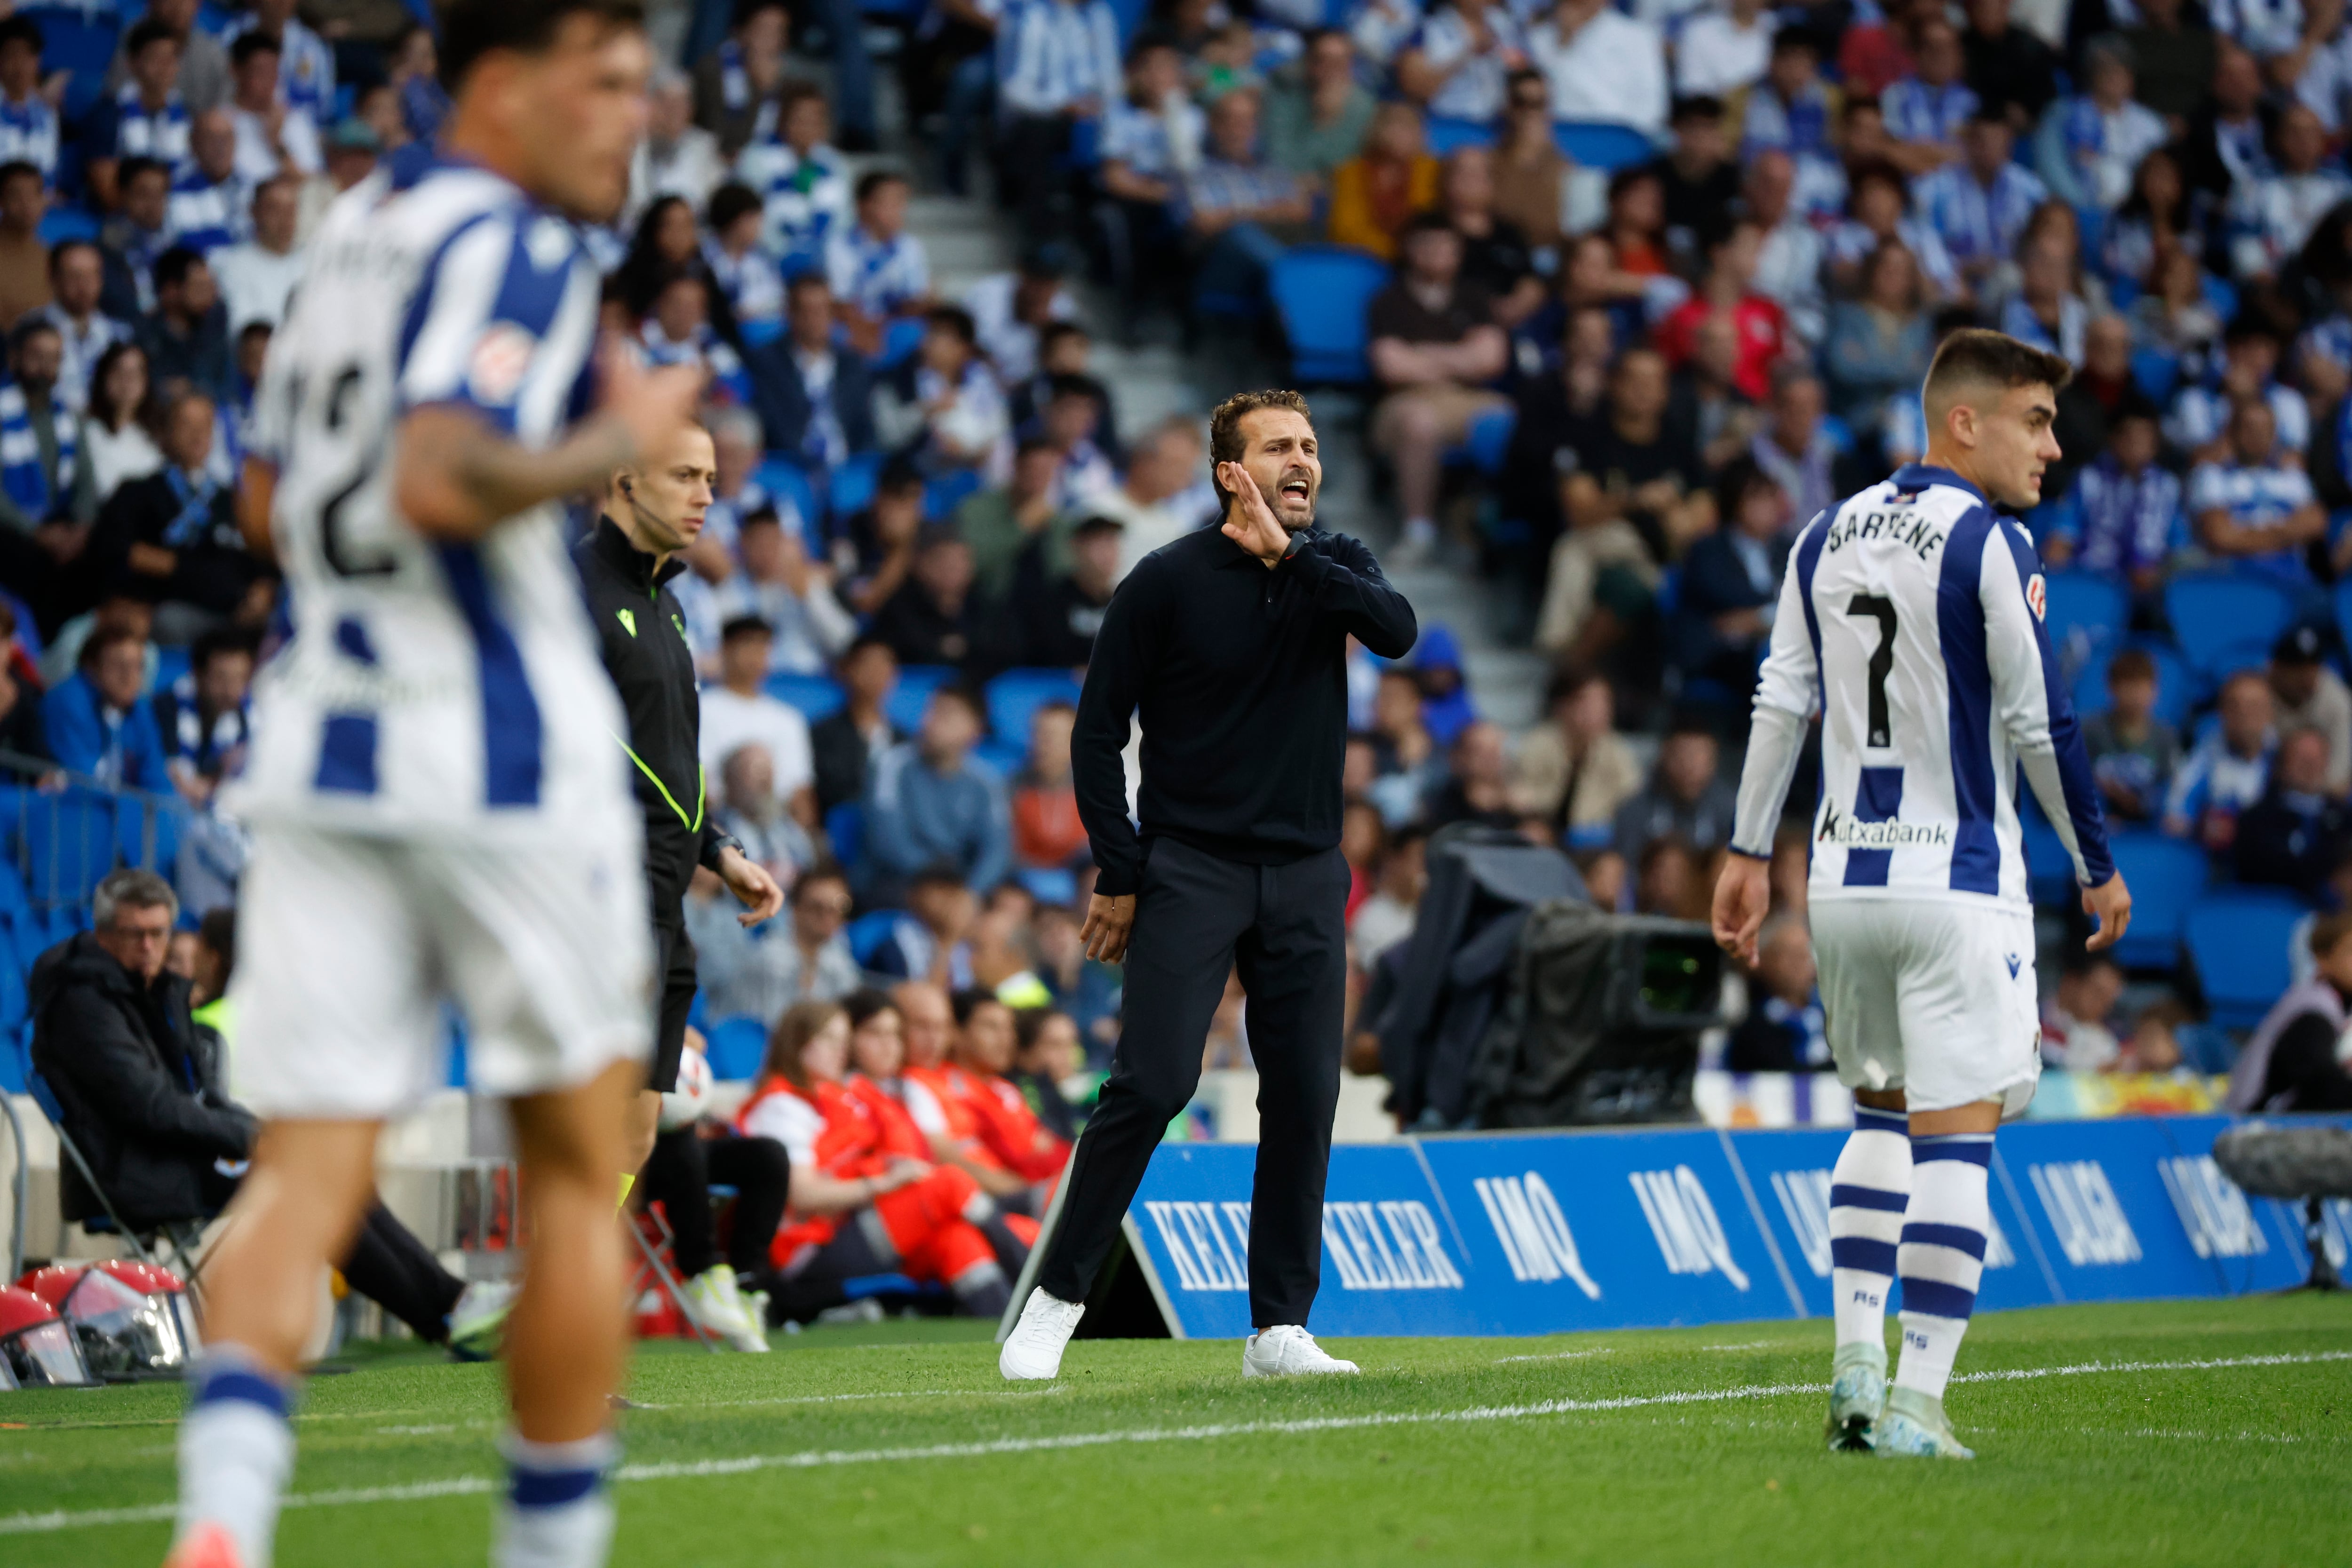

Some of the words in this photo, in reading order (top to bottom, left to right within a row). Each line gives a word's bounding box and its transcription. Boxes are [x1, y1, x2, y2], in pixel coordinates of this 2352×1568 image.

[1847, 593, 1898, 748] 7
[1817, 797, 1949, 845] Kutxabank
[1144, 1201, 1251, 1291] KELE
[1321, 1200, 1463, 1290] KELER
